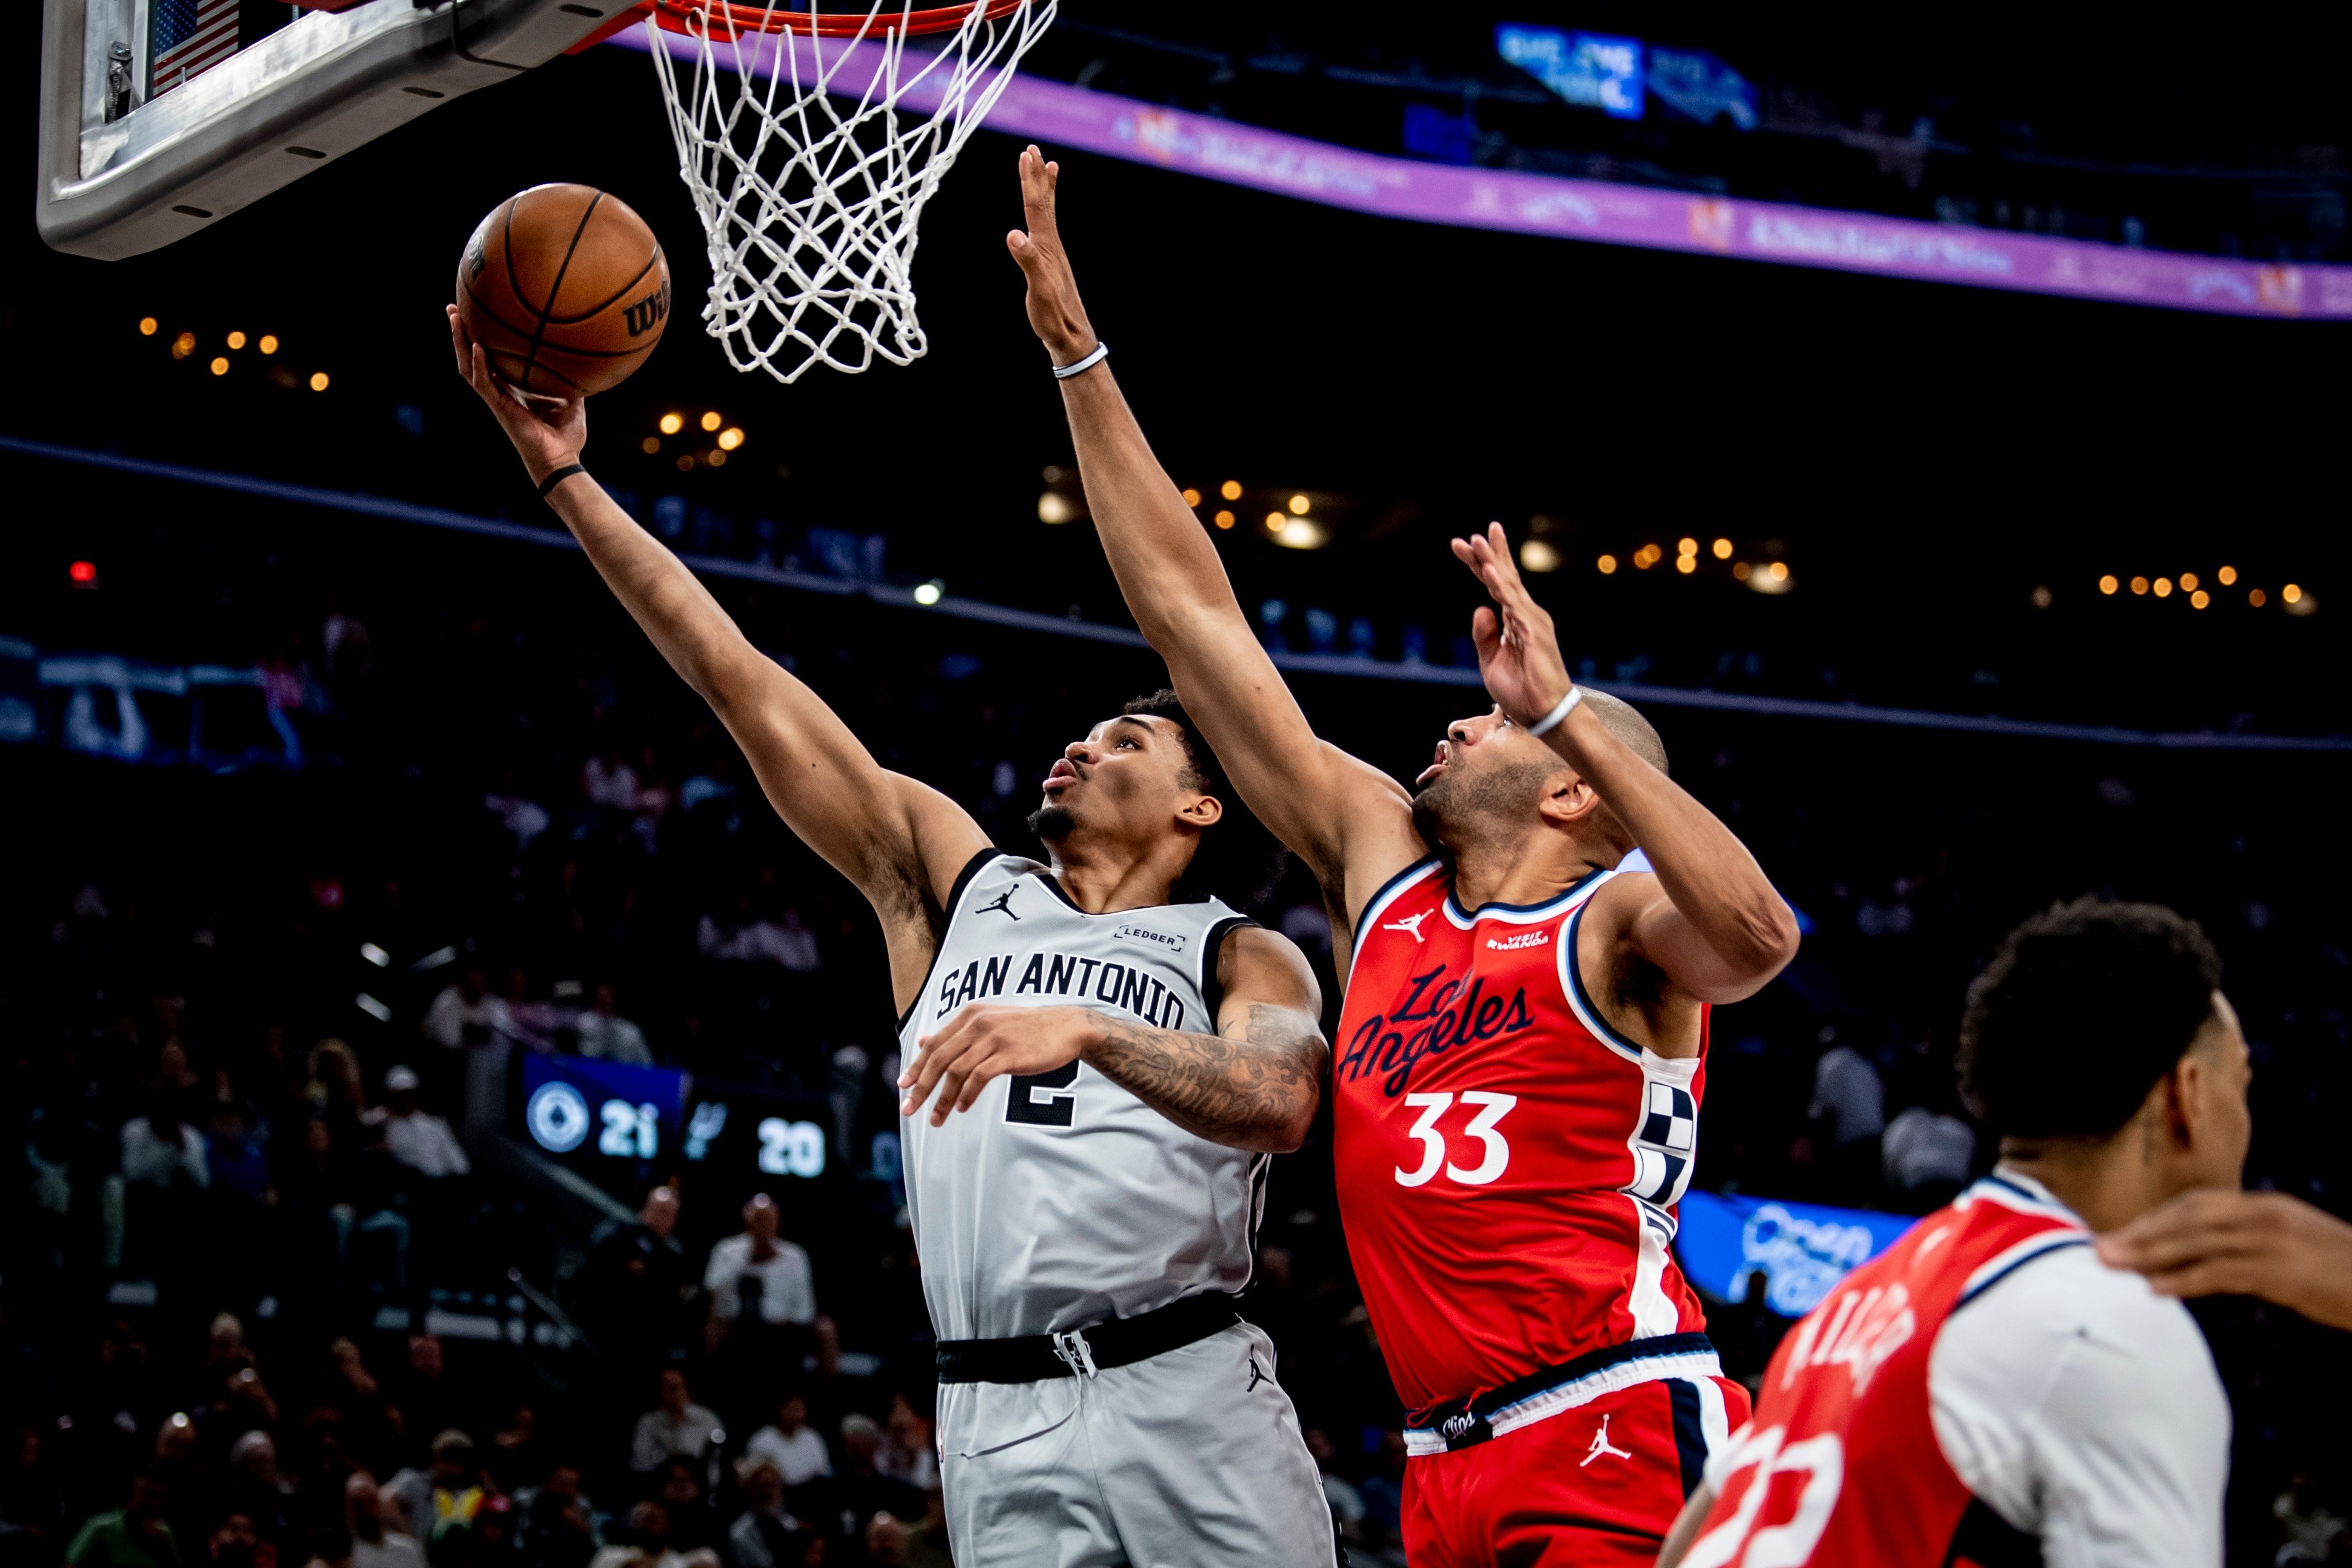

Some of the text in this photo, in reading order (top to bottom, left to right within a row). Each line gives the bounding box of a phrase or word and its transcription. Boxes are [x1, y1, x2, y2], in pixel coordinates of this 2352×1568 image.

[1124, 928, 1175, 945] LEDGER
[1486, 936, 1549, 950] RWANDA
[1508, 931, 1543, 943] VISIT
[936, 951, 1185, 1030] SAN ANTONIO
[1338, 978, 1535, 1097] Angeles
[1002, 1060, 1082, 1130] 2
[757, 1117, 825, 1178] 20
[1395, 1090, 1517, 1187] 33
[1442, 1411, 1476, 1439] Clips
